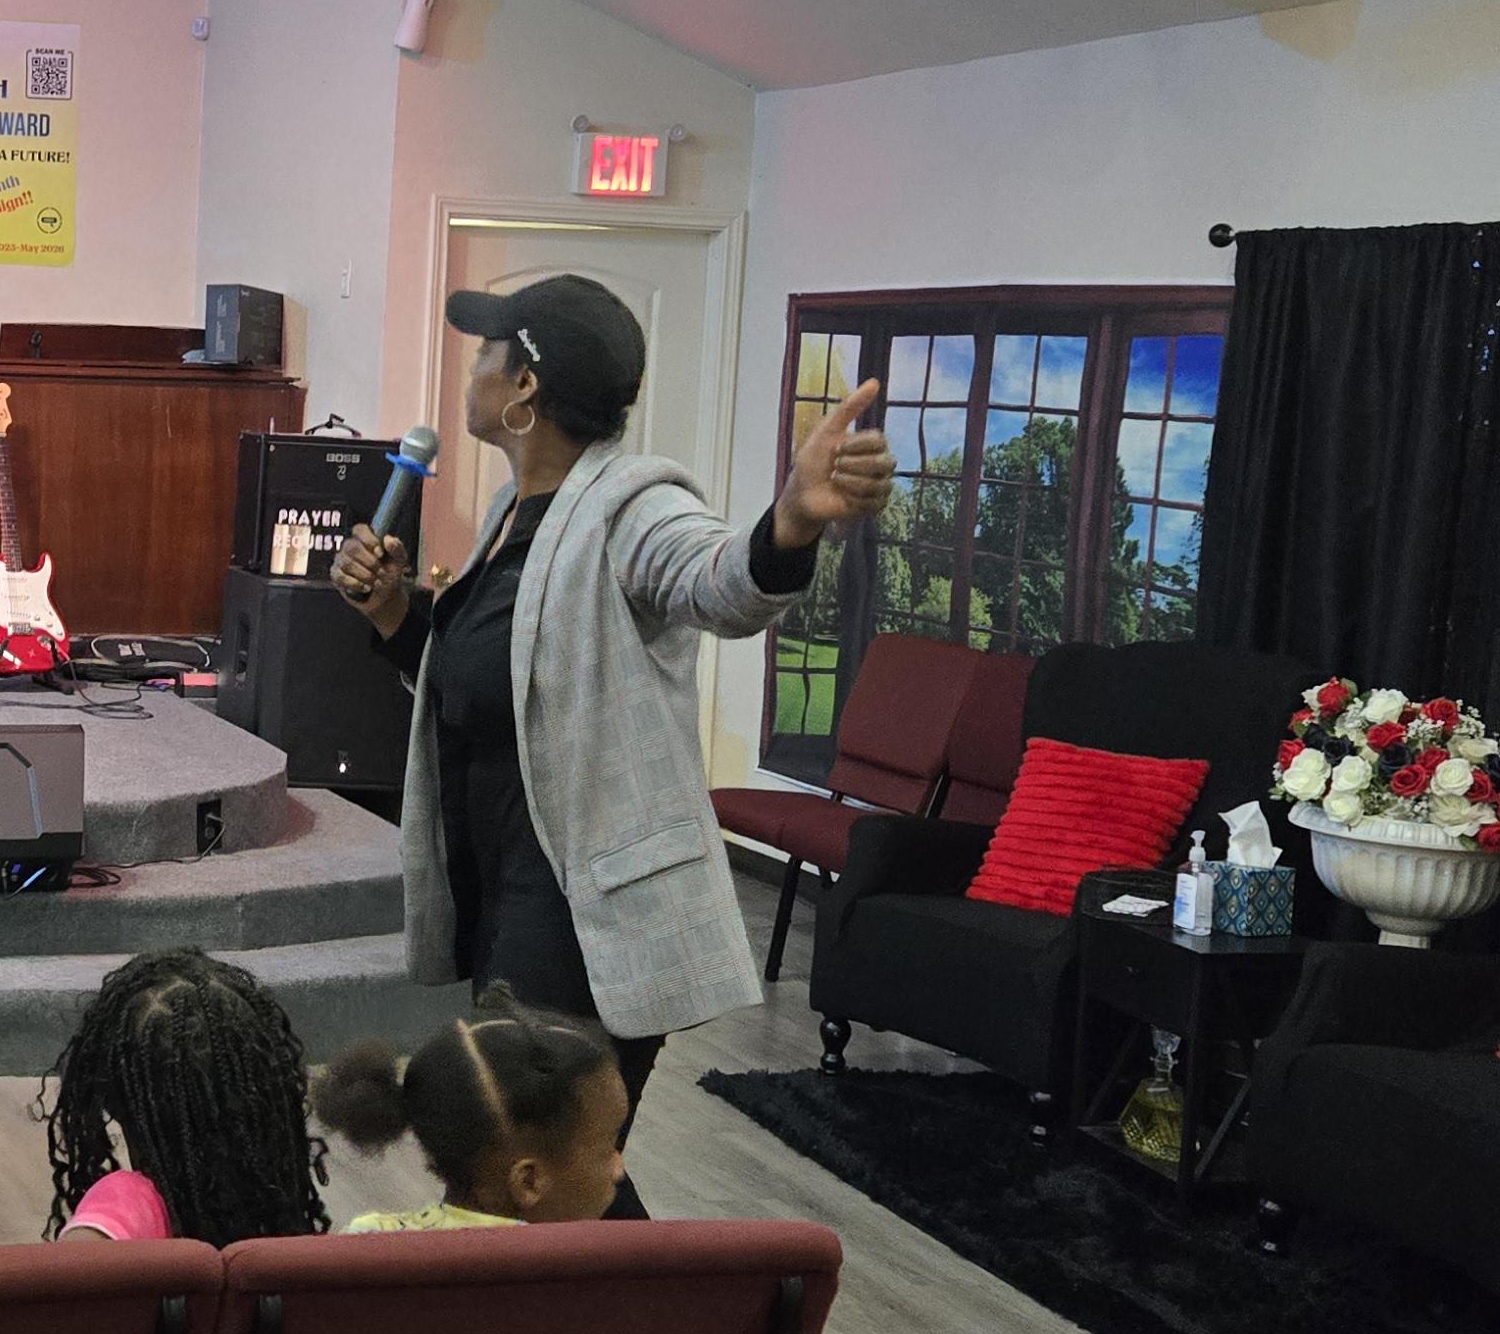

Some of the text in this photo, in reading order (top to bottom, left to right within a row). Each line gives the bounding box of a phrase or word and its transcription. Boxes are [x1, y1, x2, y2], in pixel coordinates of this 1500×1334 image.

[35, 47, 53, 55] SCAN
[10, 150, 70, 163] FUTURE!
[591, 136, 659, 192] EXIT
[278, 508, 342, 528] PRAYER
[273, 533, 345, 552] REQUEST
